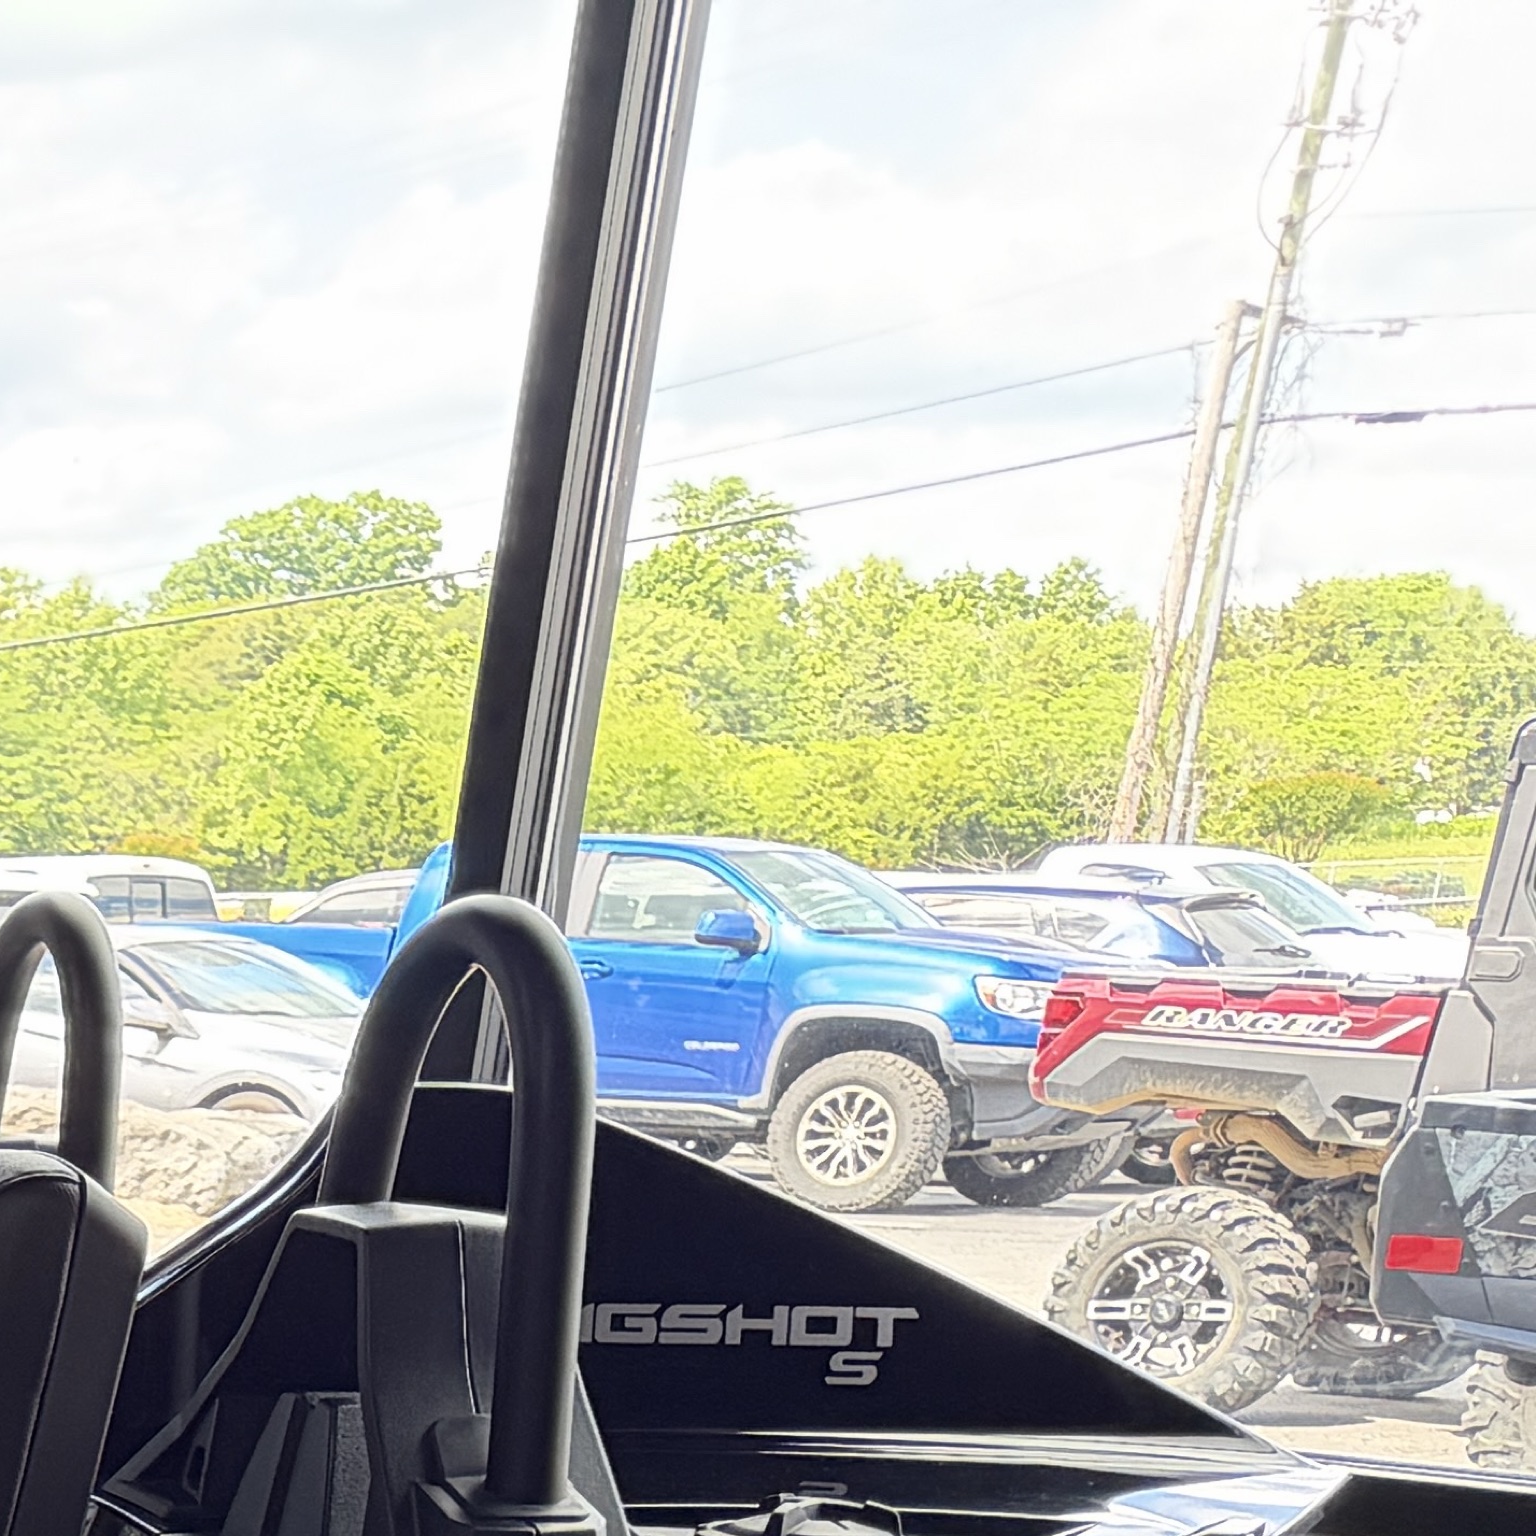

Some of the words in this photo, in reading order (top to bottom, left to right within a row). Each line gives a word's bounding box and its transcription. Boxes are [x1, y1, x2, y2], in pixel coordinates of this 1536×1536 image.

[1141, 1004, 1353, 1039] RANGER
[579, 1302, 920, 1348] GSHOT
[824, 1351, 883, 1386] S
